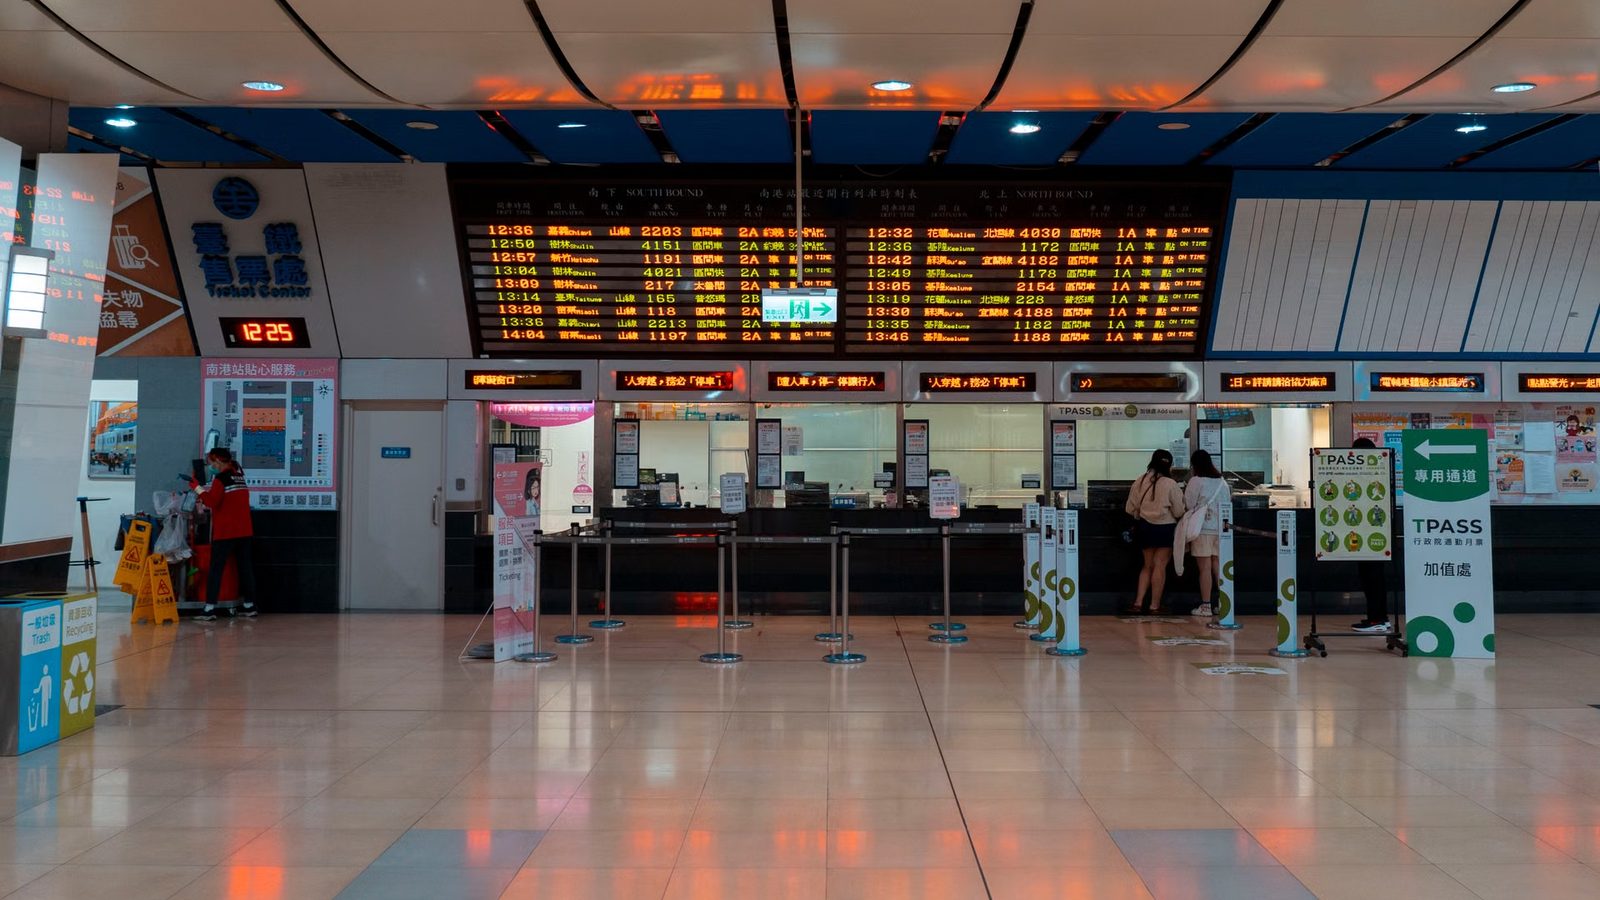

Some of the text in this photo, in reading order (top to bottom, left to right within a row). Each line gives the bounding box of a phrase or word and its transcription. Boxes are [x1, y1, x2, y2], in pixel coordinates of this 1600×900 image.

[626, 188, 664, 198] SOUTH
[666, 188, 704, 198] BOUND
[1016, 190, 1053, 198] NORTH
[1056, 190, 1093, 198] BOUND
[488, 226, 534, 236] 12:36
[642, 226, 682, 236] 2203
[692, 226, 724, 236] 區間車
[738, 228, 758, 238] 2A
[868, 228, 912, 238] 12:32
[1020, 228, 1060, 238] 4030
[1118, 228, 1136, 238] 1A
[492, 238, 534, 248] 12:50
[642, 240, 680, 250] 4151
[692, 240, 724, 250] 區間車
[740, 242, 760, 252] 2A
[868, 242, 912, 252] 12:36
[1020, 242, 1060, 252] 1172
[1070, 242, 1100, 252] 區間車
[1116, 242, 1134, 252] 1A
[492, 252, 536, 262] 12:57
[644, 254, 682, 264] 1191
[692, 254, 724, 264] 區間車
[740, 254, 760, 264] 2A
[868, 254, 912, 264] 12:42
[1018, 256, 1058, 266] 4182
[1068, 256, 1098, 266] 區間車
[1114, 256, 1134, 264] 1A
[200, 255, 308, 284] 售票處
[494, 266, 538, 276] 13:04
[642, 268, 682, 278] 4021
[740, 268, 760, 278] 2A
[868, 268, 912, 278] 12:49
[1018, 268, 1056, 278] 1178
[1066, 268, 1096, 278] 區間車
[1114, 268, 1132, 278] 1A
[496, 278, 540, 288] 13:09
[644, 280, 674, 290] 217
[740, 280, 760, 290] 2A
[868, 282, 910, 290] 13:05
[1016, 282, 1056, 292] 2154
[1066, 282, 1096, 292] 區間車
[1112, 282, 1130, 290] 1A
[206, 284, 310, 297] Ticket Center
[498, 292, 540, 302] 13:14
[648, 294, 676, 304] 165
[742, 294, 760, 304] 2B
[868, 294, 910, 304] 13:19
[1016, 294, 1044, 304] 228
[1110, 294, 1128, 304] 1A
[500, 304, 542, 314] 13:20
[648, 306, 676, 316] 118
[696, 306, 726, 316] 區間車
[742, 306, 760, 316] 2A
[866, 306, 910, 316] 13:30
[1014, 308, 1054, 318] 4188
[1062, 308, 1092, 316] 區間車
[1108, 308, 1126, 316] 1A
[502, 318, 544, 326] 13:36
[648, 320, 686, 328] 2213
[696, 320, 726, 328] 區間車
[742, 320, 760, 328] 2A
[866, 320, 910, 328] 13:35
[1014, 320, 1052, 330] 1182
[1062, 320, 1092, 330] 區間車
[1108, 320, 1126, 328] 1A
[502, 330, 544, 340] 14:04
[650, 332, 688, 340] 1197
[696, 332, 728, 340] 區間車
[742, 332, 762, 340] 2A
[866, 332, 908, 342] 13:46
[1014, 332, 1050, 342] 1188
[1060, 332, 1090, 342] 區間車
[1106, 332, 1124, 342] 1A
[206, 363, 296, 376] 南港站貼心服務
[1318, 455, 1364, 465] TPASS
[1415, 469, 1477, 483] 專用通道
[1412, 519, 1482, 534] TPASS
[1413, 538, 1483, 546] 行政院通勤月票
[1424, 562, 1471, 577] 加值處
[499, 572, 520, 582] Ticketing
[27, 613, 55, 630] 一般垃圾
[66, 622, 94, 638] Recycling
[32, 631, 51, 646] Trash
